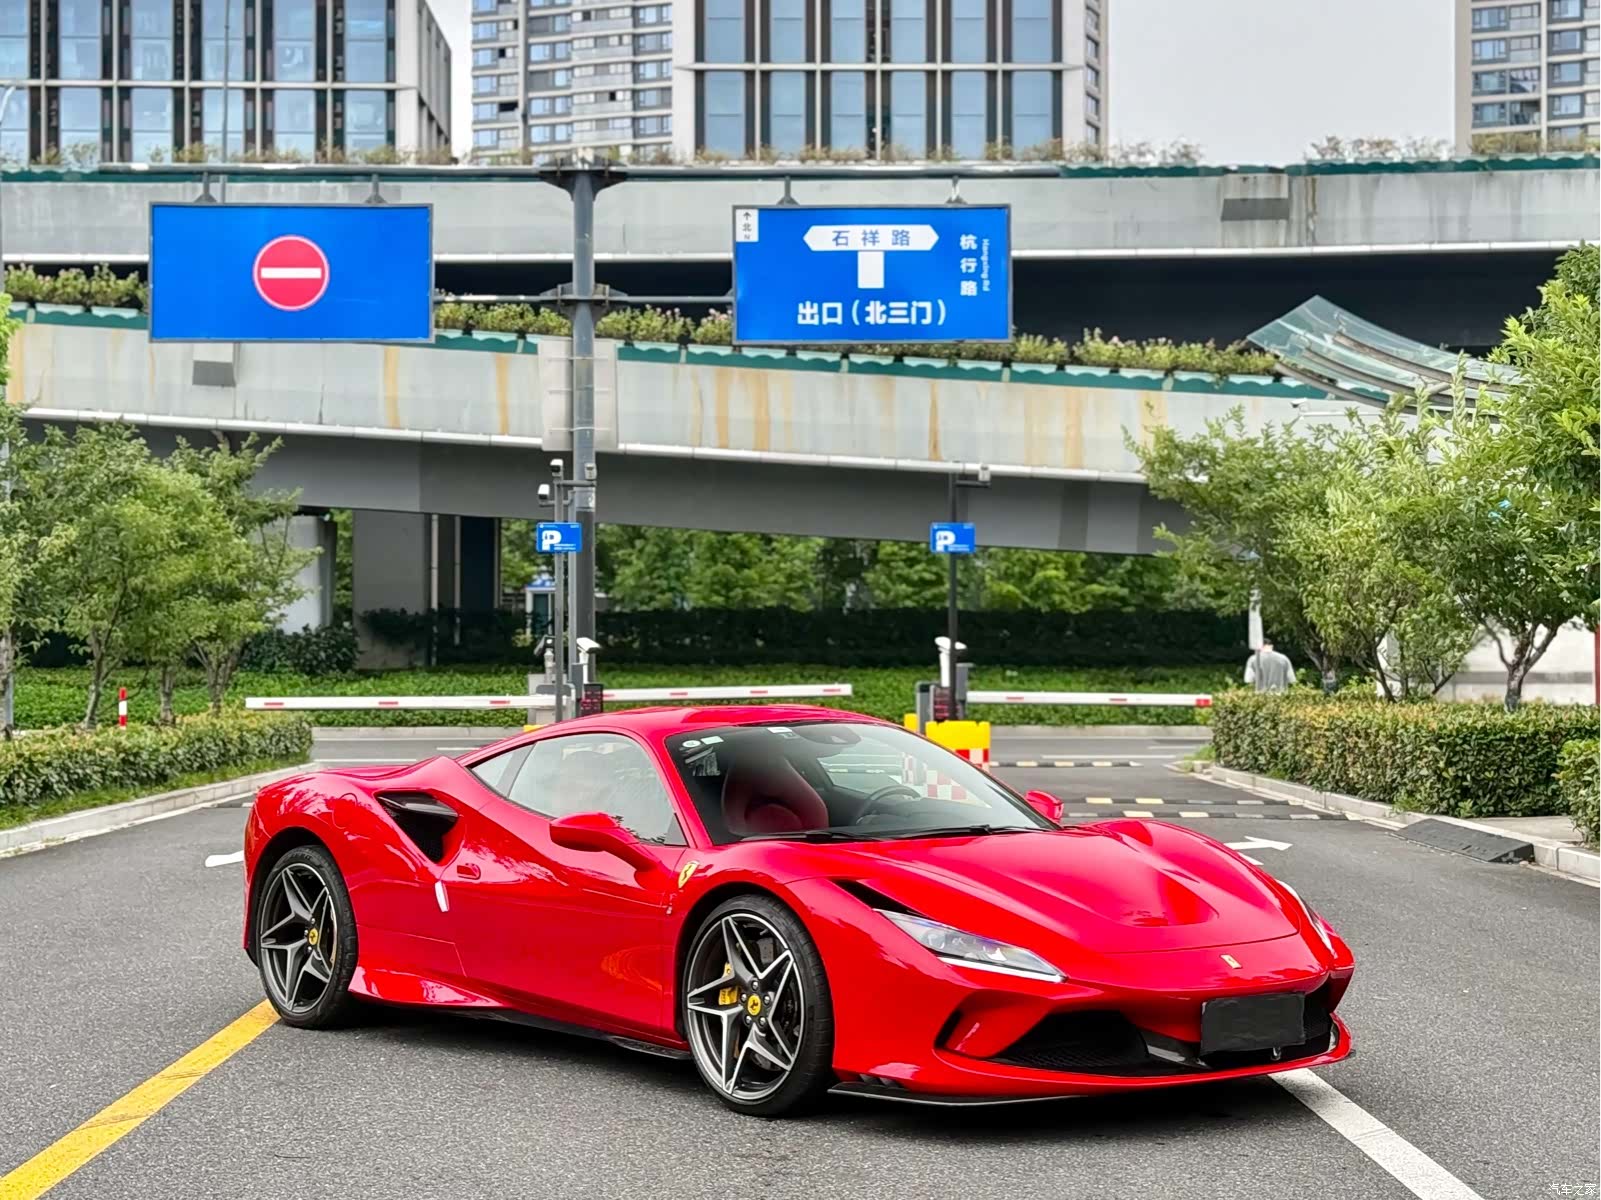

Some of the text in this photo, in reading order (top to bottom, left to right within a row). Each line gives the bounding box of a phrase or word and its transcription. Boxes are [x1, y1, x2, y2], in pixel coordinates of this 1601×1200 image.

[742, 222, 752, 232] 北
[832, 229, 911, 247] 石祥路
[960, 234, 978, 297] 杭行路
[541, 530, 562, 551] P
